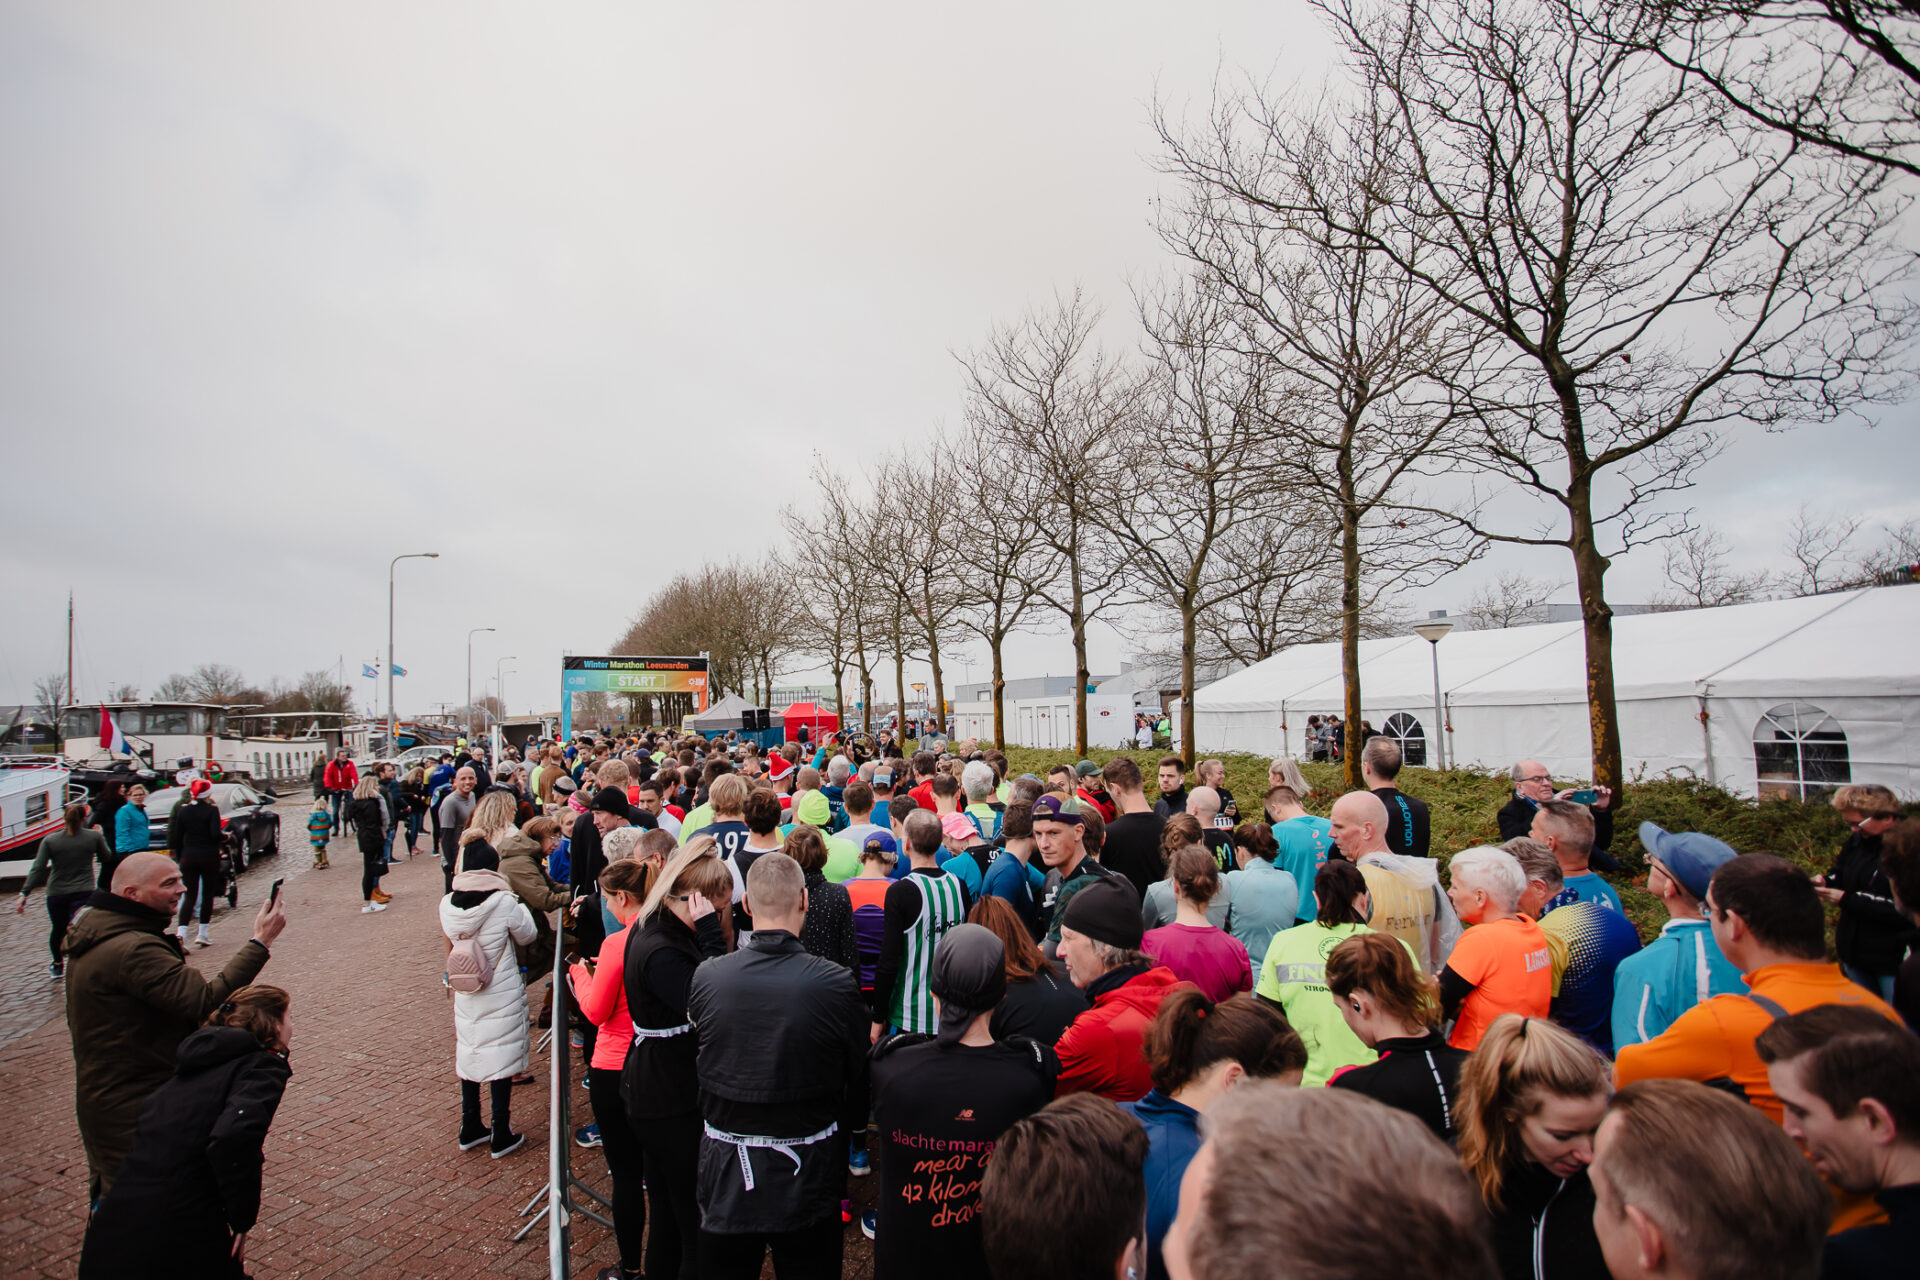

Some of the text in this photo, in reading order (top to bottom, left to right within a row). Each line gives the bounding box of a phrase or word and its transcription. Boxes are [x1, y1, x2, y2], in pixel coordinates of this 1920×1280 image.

[584, 660, 689, 670] Winter Marathon Leeuwarden
[618, 676, 656, 687] START
[1395, 795, 1413, 847] salomon
[892, 1129, 995, 1152] slachtemara
[913, 1154, 973, 1175] mear
[902, 1174, 984, 1205] 42 kilom
